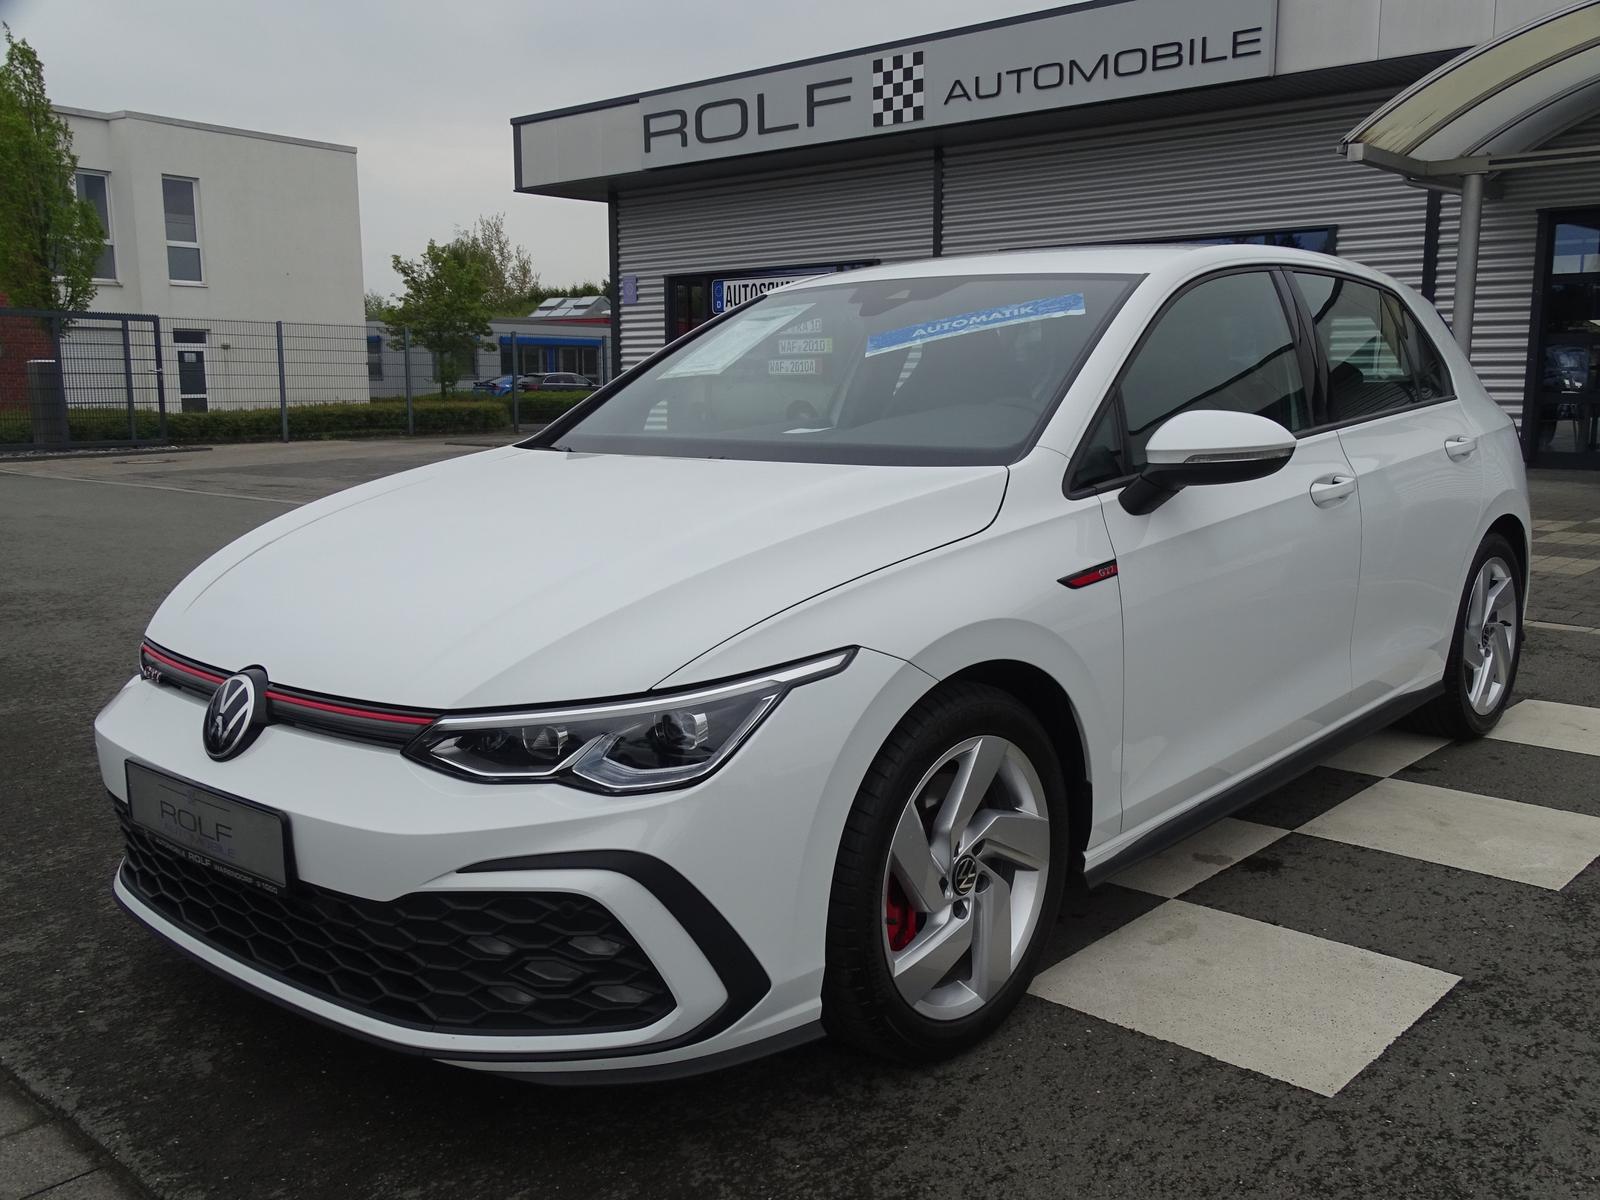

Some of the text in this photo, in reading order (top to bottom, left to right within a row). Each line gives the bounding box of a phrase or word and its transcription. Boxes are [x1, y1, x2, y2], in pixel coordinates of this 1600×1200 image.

[643, 26, 1262, 153] ROLF AUTOMOBILE
[911, 305, 1034, 338] AUTOMATIK
[160, 799, 233, 842] ROLF
